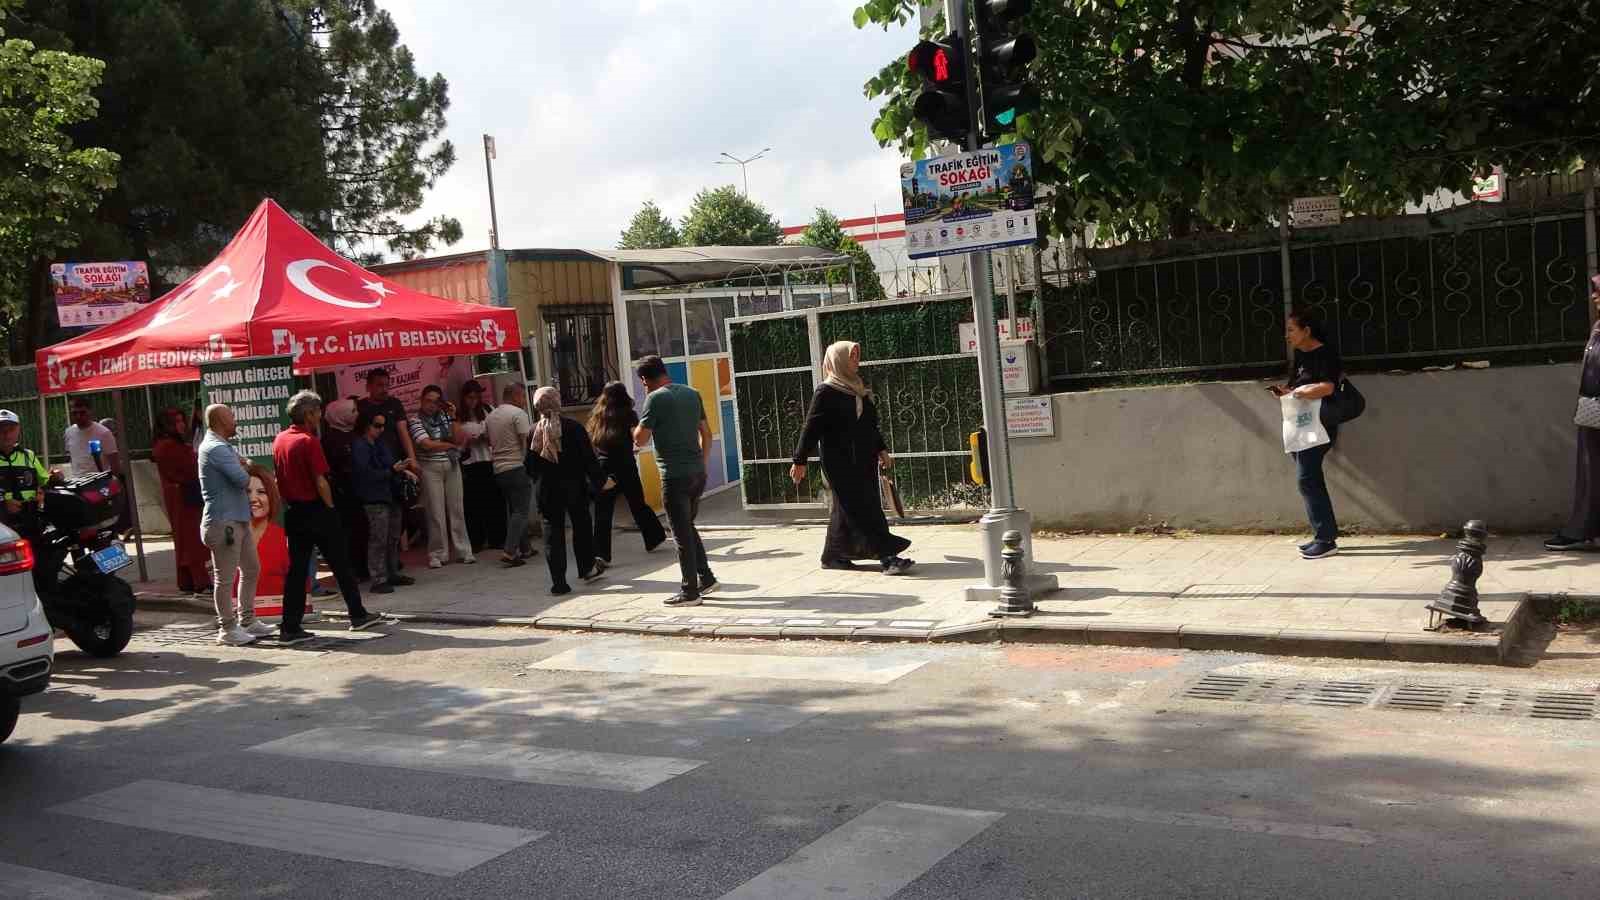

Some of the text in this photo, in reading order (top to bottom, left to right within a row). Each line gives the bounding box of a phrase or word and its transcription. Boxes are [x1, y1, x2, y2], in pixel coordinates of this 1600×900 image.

[929, 153, 998, 176] TRAFİK EĞİTİM
[940, 166, 991, 187] SOKAĞI
[76, 265, 127, 275] TRAFİK EĞİTİM
[84, 273, 122, 284] SOKAĞI
[307, 326, 483, 354] T.C. İZMİT BELEDİYESİ
[71, 360, 96, 378] T.C.
[100, 353, 134, 375] İZMİT
[204, 366, 291, 386] SINAVA GİRECEK
[208, 385, 290, 404] TÜM ADAYLARA
[231, 404, 280, 421] ÖNÜLDEN
[236, 423, 281, 440] ŞARILAR
